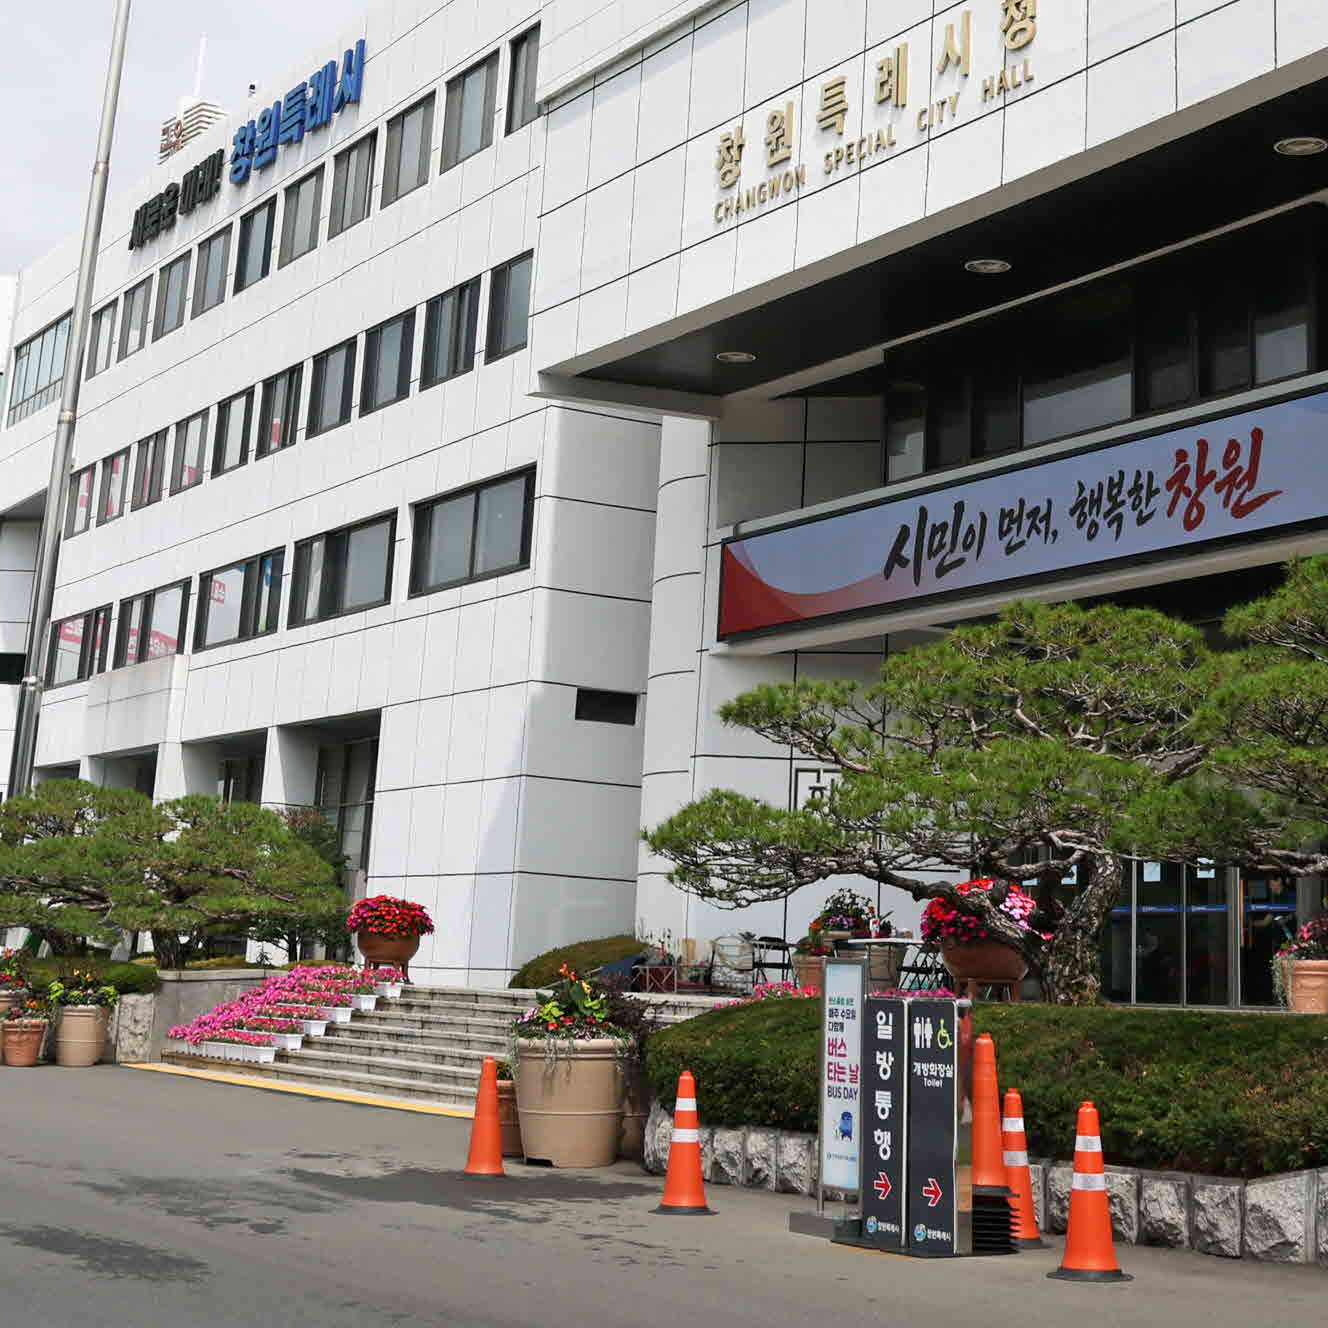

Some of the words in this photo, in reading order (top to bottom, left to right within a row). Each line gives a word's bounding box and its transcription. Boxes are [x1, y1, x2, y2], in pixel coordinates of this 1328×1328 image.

[229, 39, 365, 185] 창원특례시
[713, 164, 806, 225] CHANGWON
[823, 125, 896, 175] SPECIAL
[917, 92, 960, 132] CITY
[981, 58, 1034, 102] HALL
[883, 501, 988, 587] 시민이
[997, 498, 1059, 557] 먼저,
[1069, 469, 1159, 541] 행복한
[1165, 426, 1284, 531] 창원
[827, 1038, 847, 1058] 버스
[827, 1061, 847, 1084] 타는
[913, 1062, 953, 1078] 개방화장실
[827, 1086, 842, 1099] BUS
[843, 1087, 859, 1101] DAY
[874, 1010, 894, 1160] 일방통행
[923, 1078, 943, 1088] Toilet
